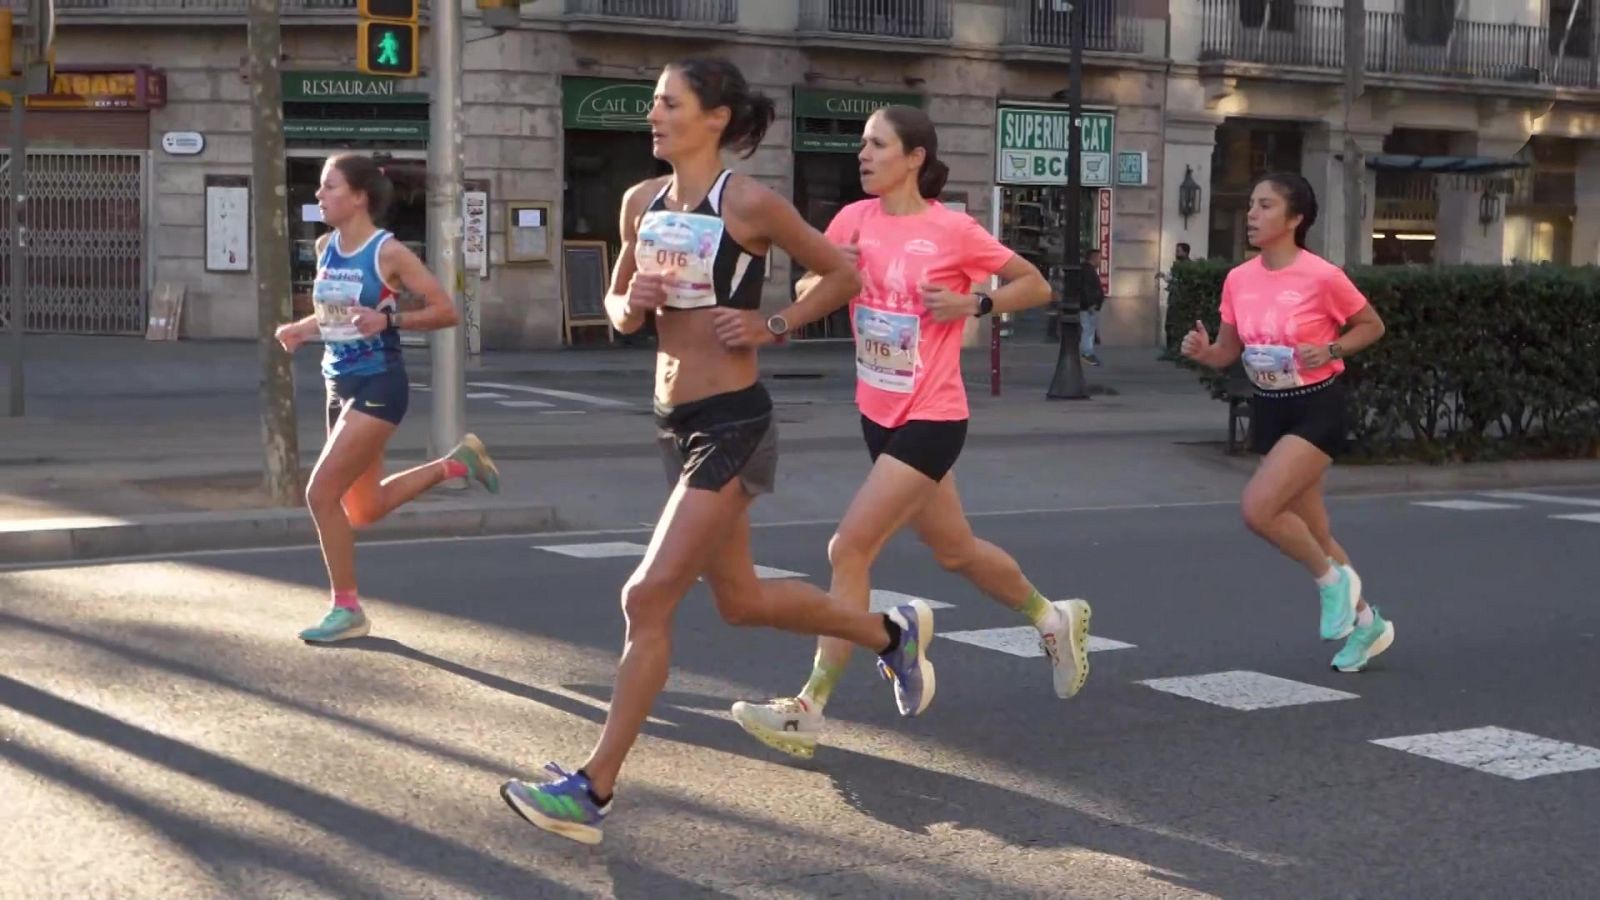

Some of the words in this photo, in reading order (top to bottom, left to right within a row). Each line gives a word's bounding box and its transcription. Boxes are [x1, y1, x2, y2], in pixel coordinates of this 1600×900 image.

[302, 80, 394, 96] RESTAURANT
[1005, 113, 1107, 150] SUPERMECAT
[656, 249, 688, 267] 016
[865, 339, 891, 357] 016
